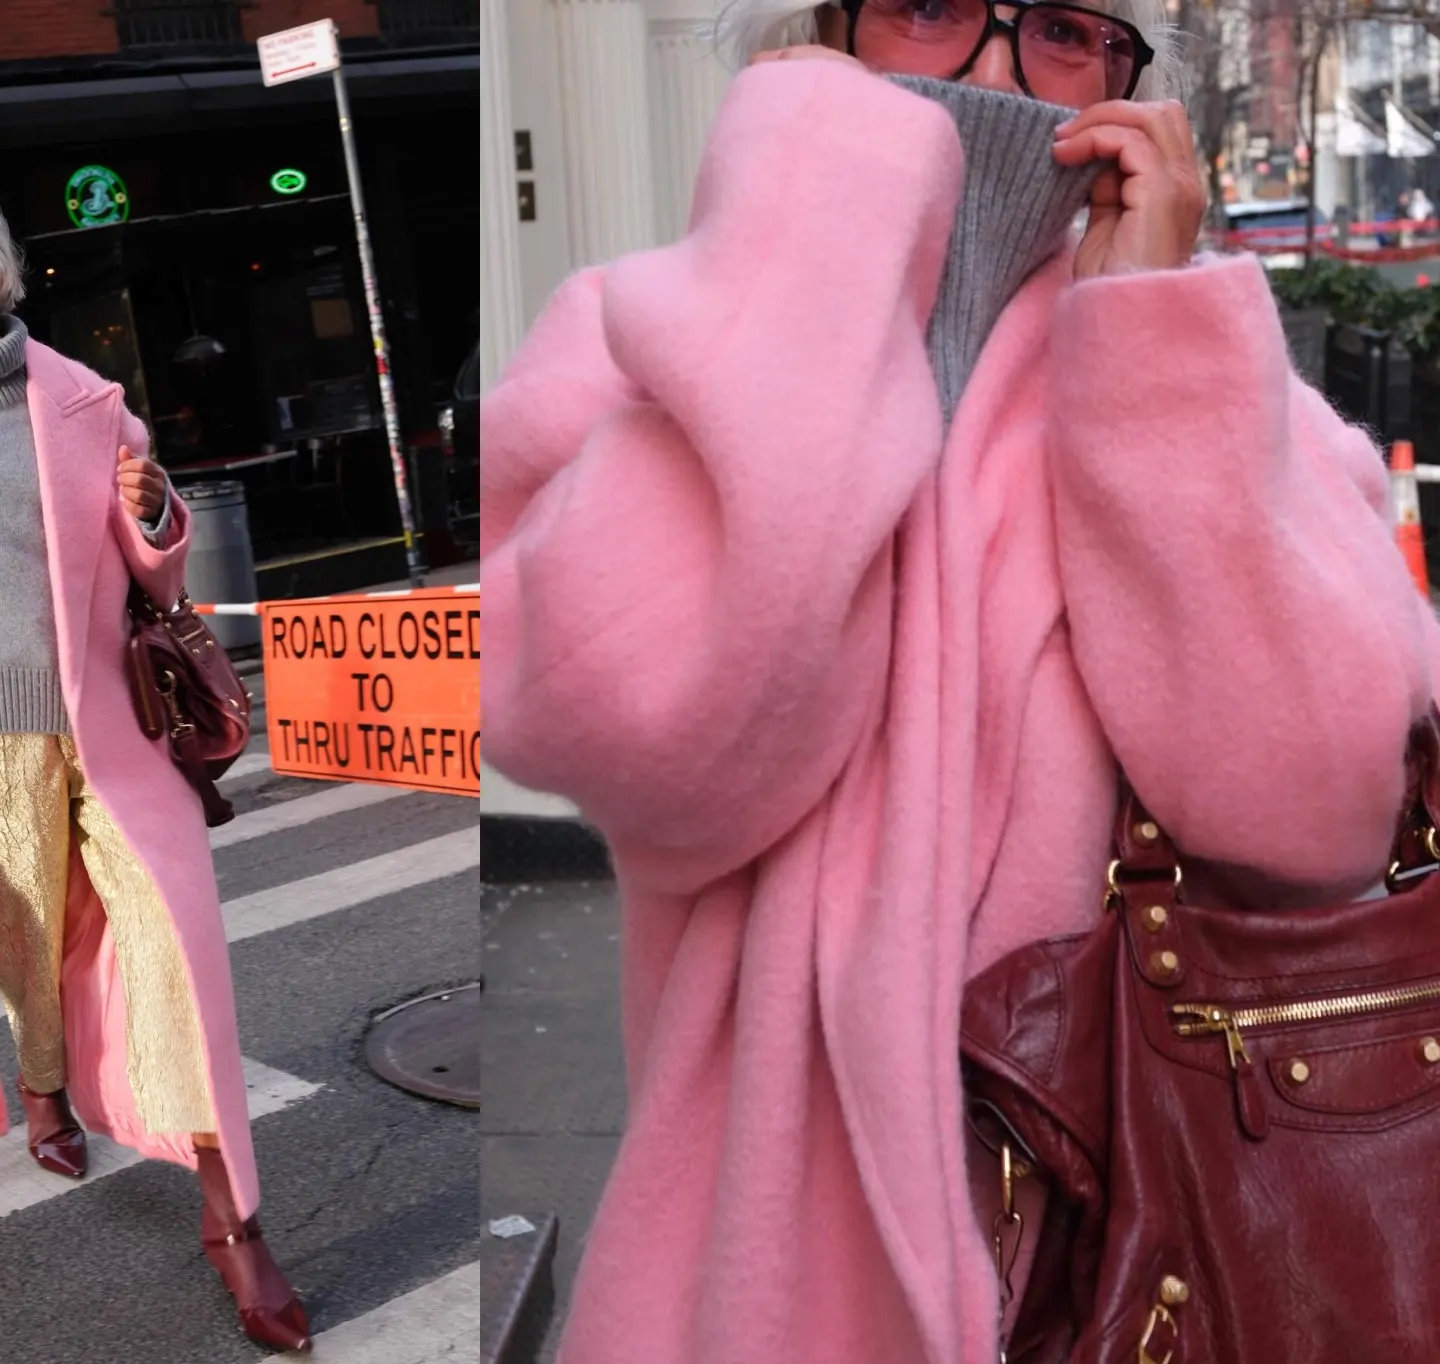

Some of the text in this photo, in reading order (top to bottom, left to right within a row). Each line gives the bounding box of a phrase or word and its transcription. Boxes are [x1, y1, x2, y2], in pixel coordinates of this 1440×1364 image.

[271, 614, 348, 659] ROAD
[351, 673, 394, 713] TO
[277, 719, 350, 768] THRU
